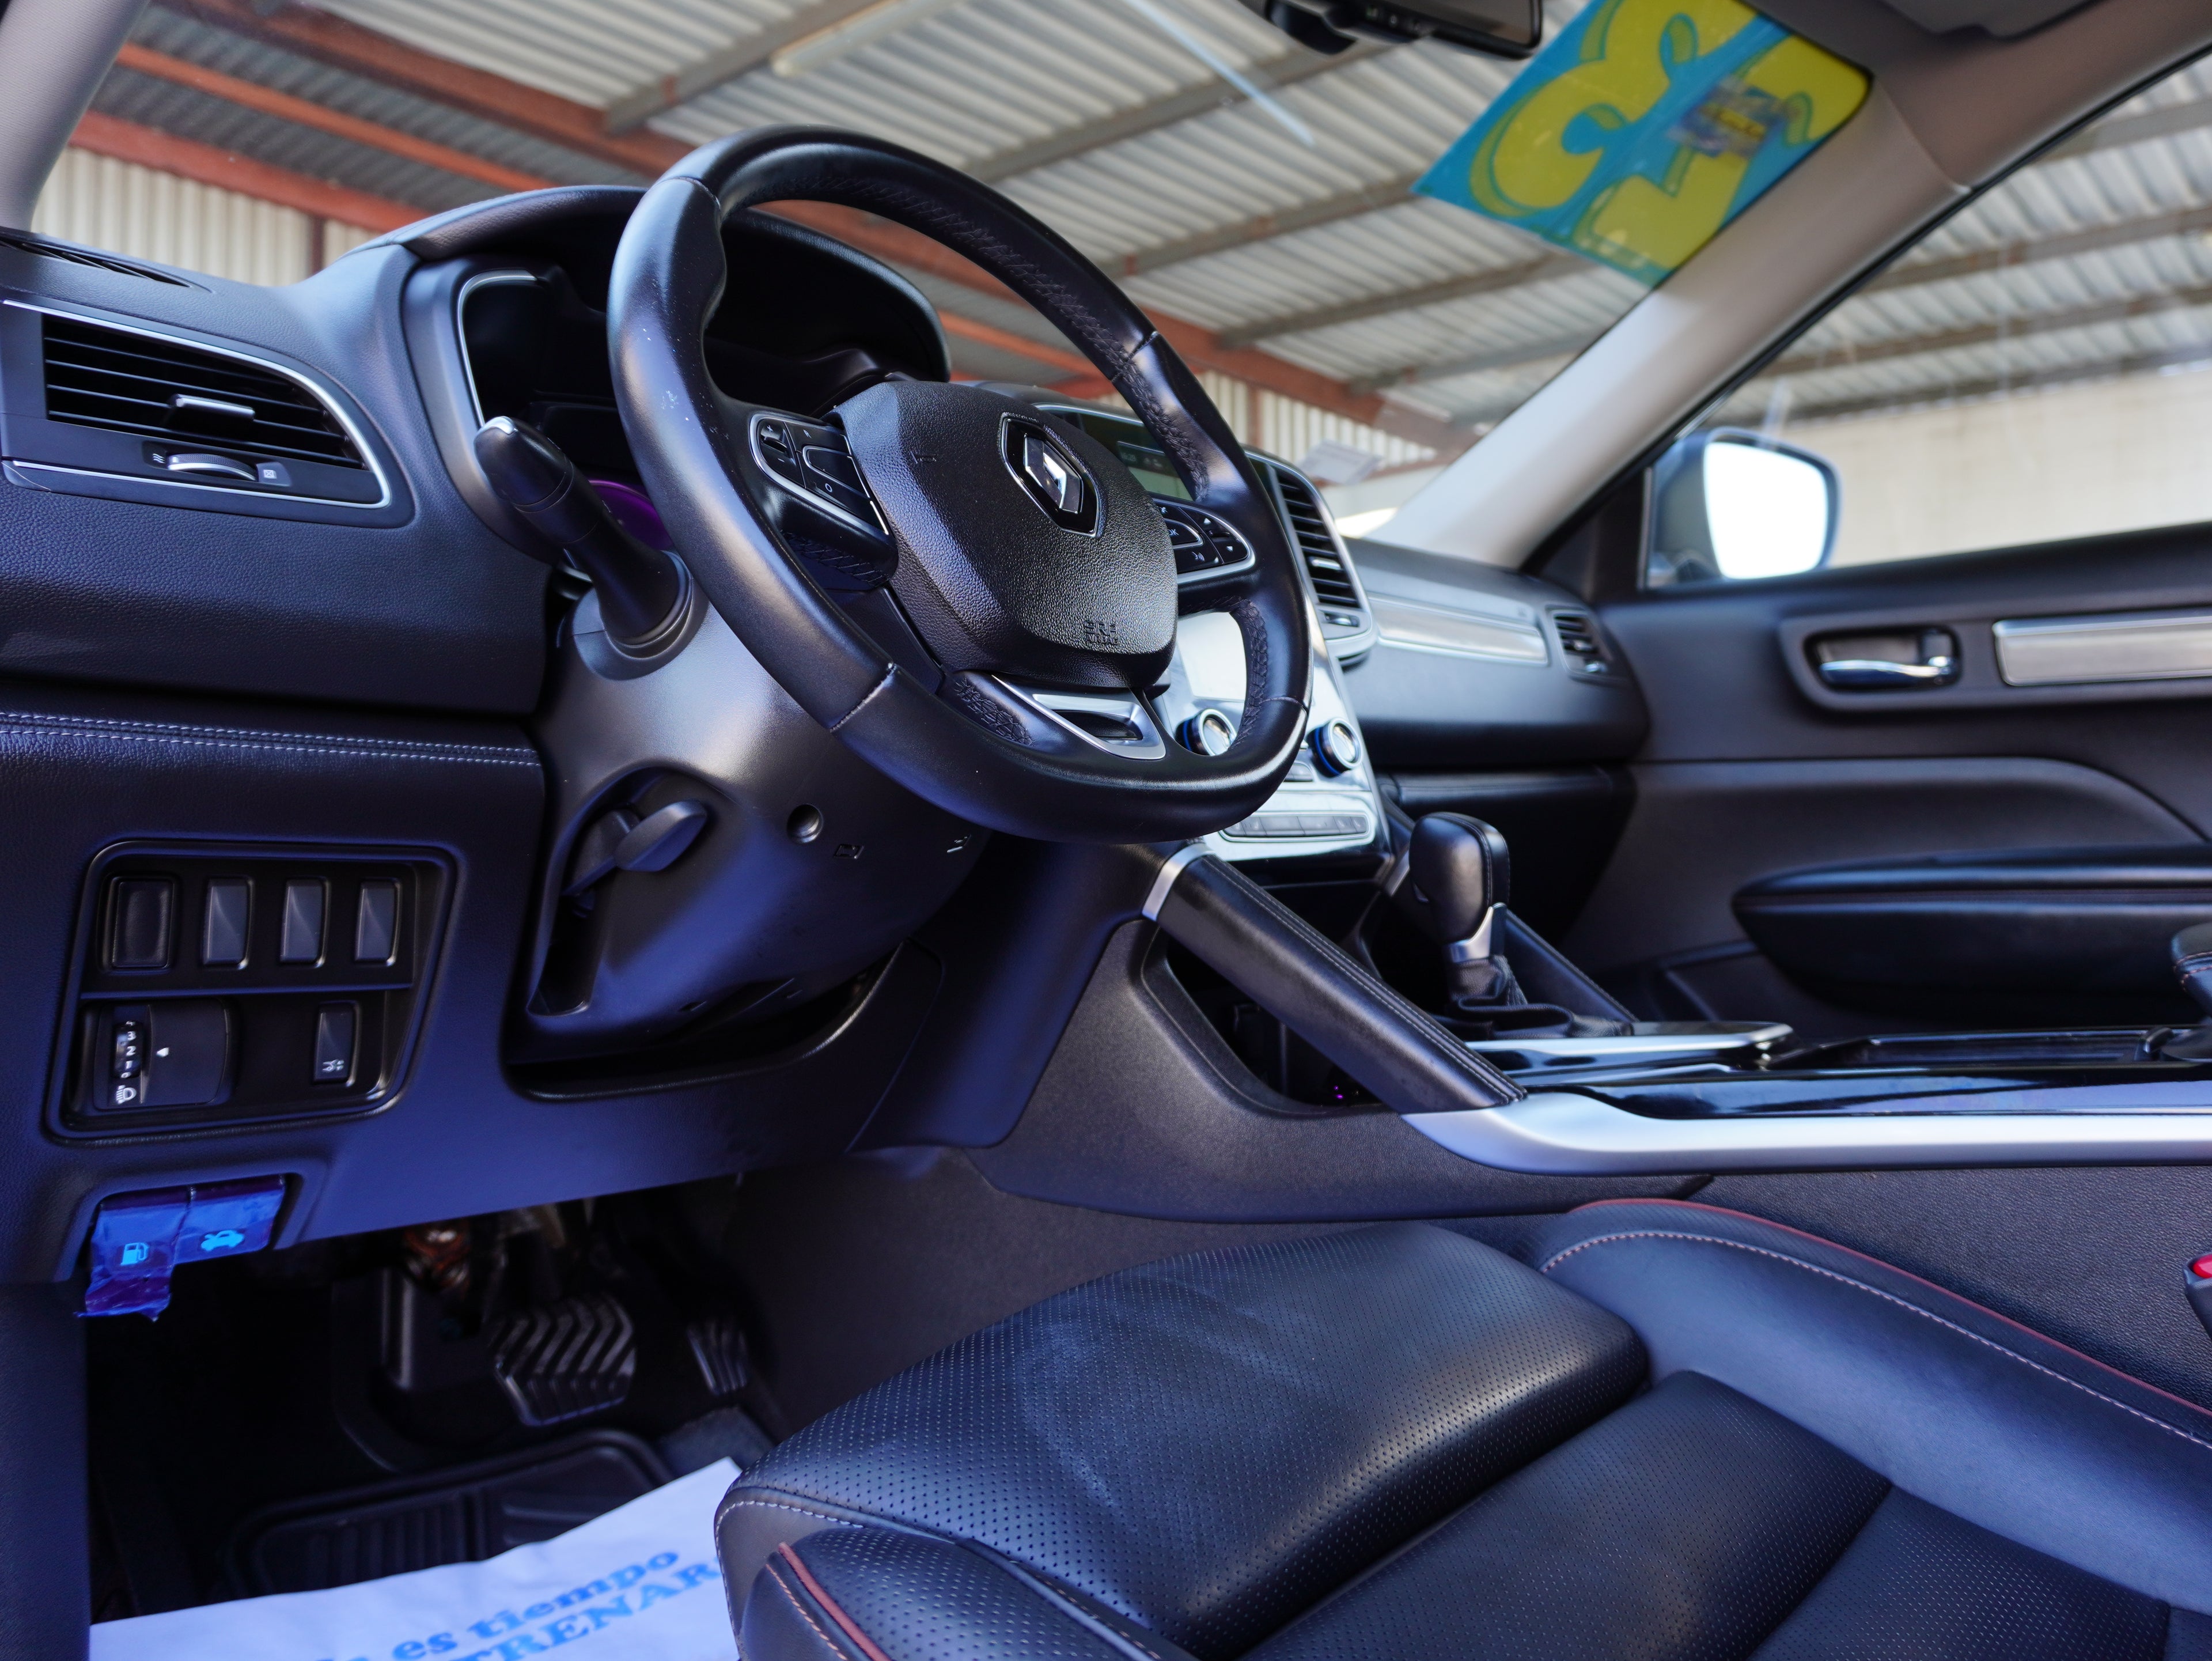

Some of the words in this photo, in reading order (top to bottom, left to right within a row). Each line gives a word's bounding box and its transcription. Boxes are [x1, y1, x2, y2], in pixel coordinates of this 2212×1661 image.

[127, 1031, 137, 1042] 3
[126, 1046, 137, 1057] 2
[126, 1060, 133, 1069] 1
[392, 1632, 458, 1661] es
[467, 1552, 679, 1639] tiempo
